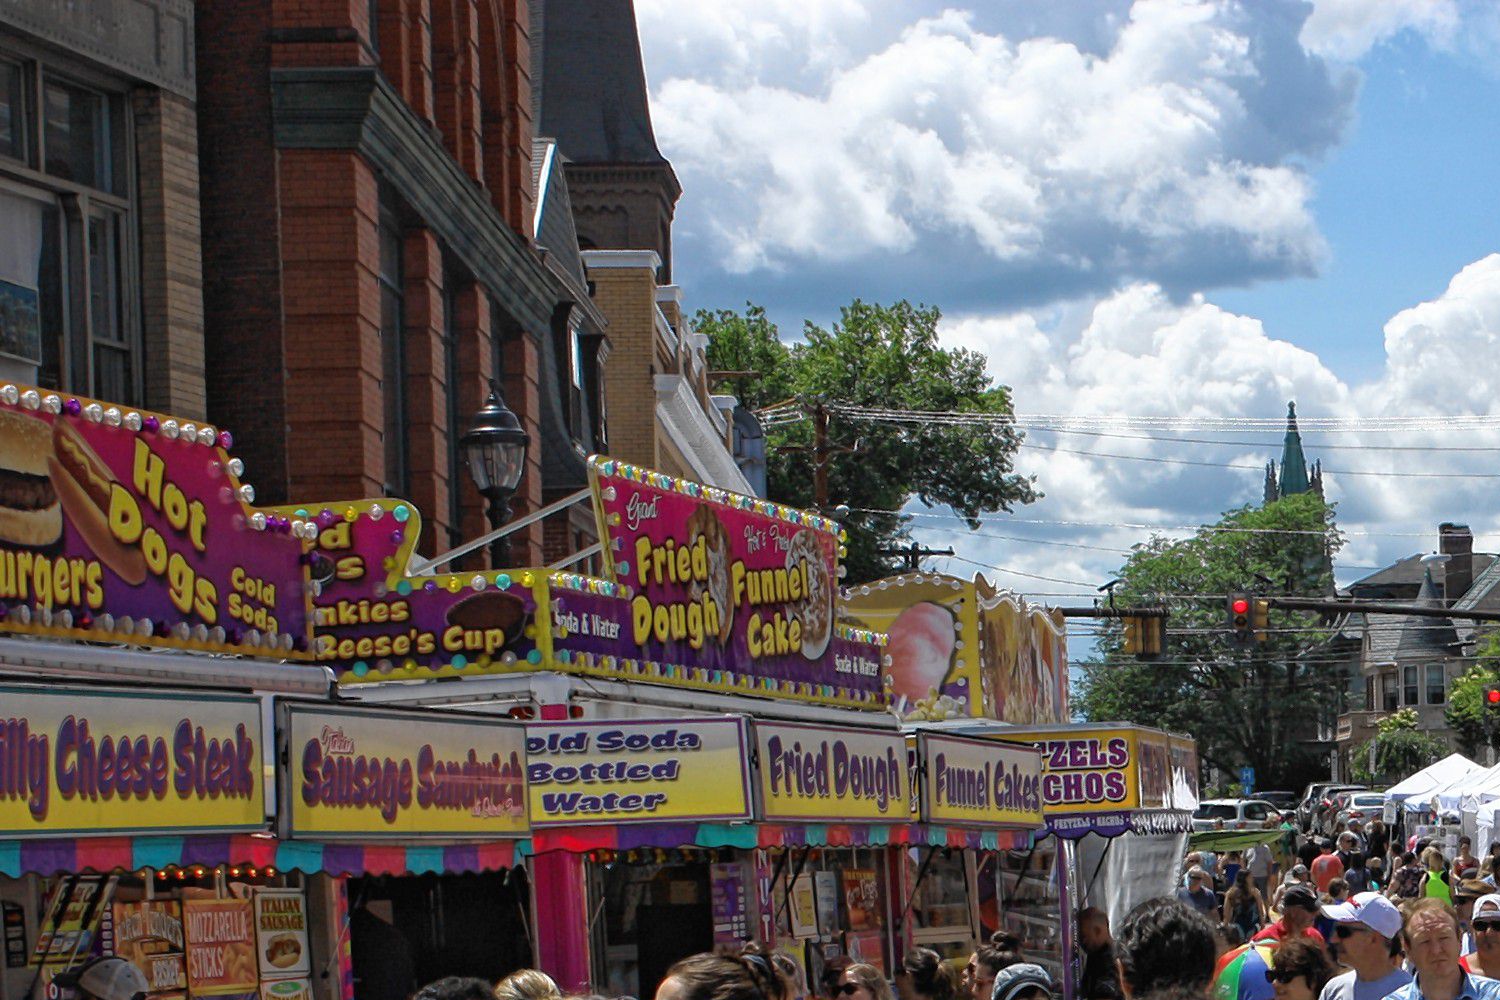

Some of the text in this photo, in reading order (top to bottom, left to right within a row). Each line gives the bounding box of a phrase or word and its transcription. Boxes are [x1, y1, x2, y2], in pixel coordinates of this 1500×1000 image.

[132, 436, 207, 552] Hot
[108, 484, 218, 624] Dogs
[634, 534, 709, 588] Fried
[230, 567, 276, 608] Cold
[730, 556, 810, 608] Funnel
[228, 598, 279, 635] Soda
[581, 612, 590, 635] &
[591, 613, 620, 640] Water
[631, 590, 720, 650] Dough
[315, 628, 437, 660] Reese's
[442, 625, 506, 656] Cup
[746, 611, 802, 660] Cake
[859, 656, 879, 677] Water
[55, 714, 168, 801] Cheese
[173, 718, 254, 801] Steak
[596, 729, 702, 752] Soda
[301, 737, 525, 824] Sausage Sandwich
[526, 759, 681, 786] Bottled
[767, 734, 903, 816] Fried Dough
[935, 752, 1041, 813] Funnel Cakes
[1043, 771, 1128, 805] CHOS
[541, 788, 667, 815] Water
[260, 914, 304, 931] SAUSAGE
[261, 898, 300, 914] ITALIAN
[187, 910, 248, 943] MOZZARELLA
[190, 946, 225, 979] STICKS
